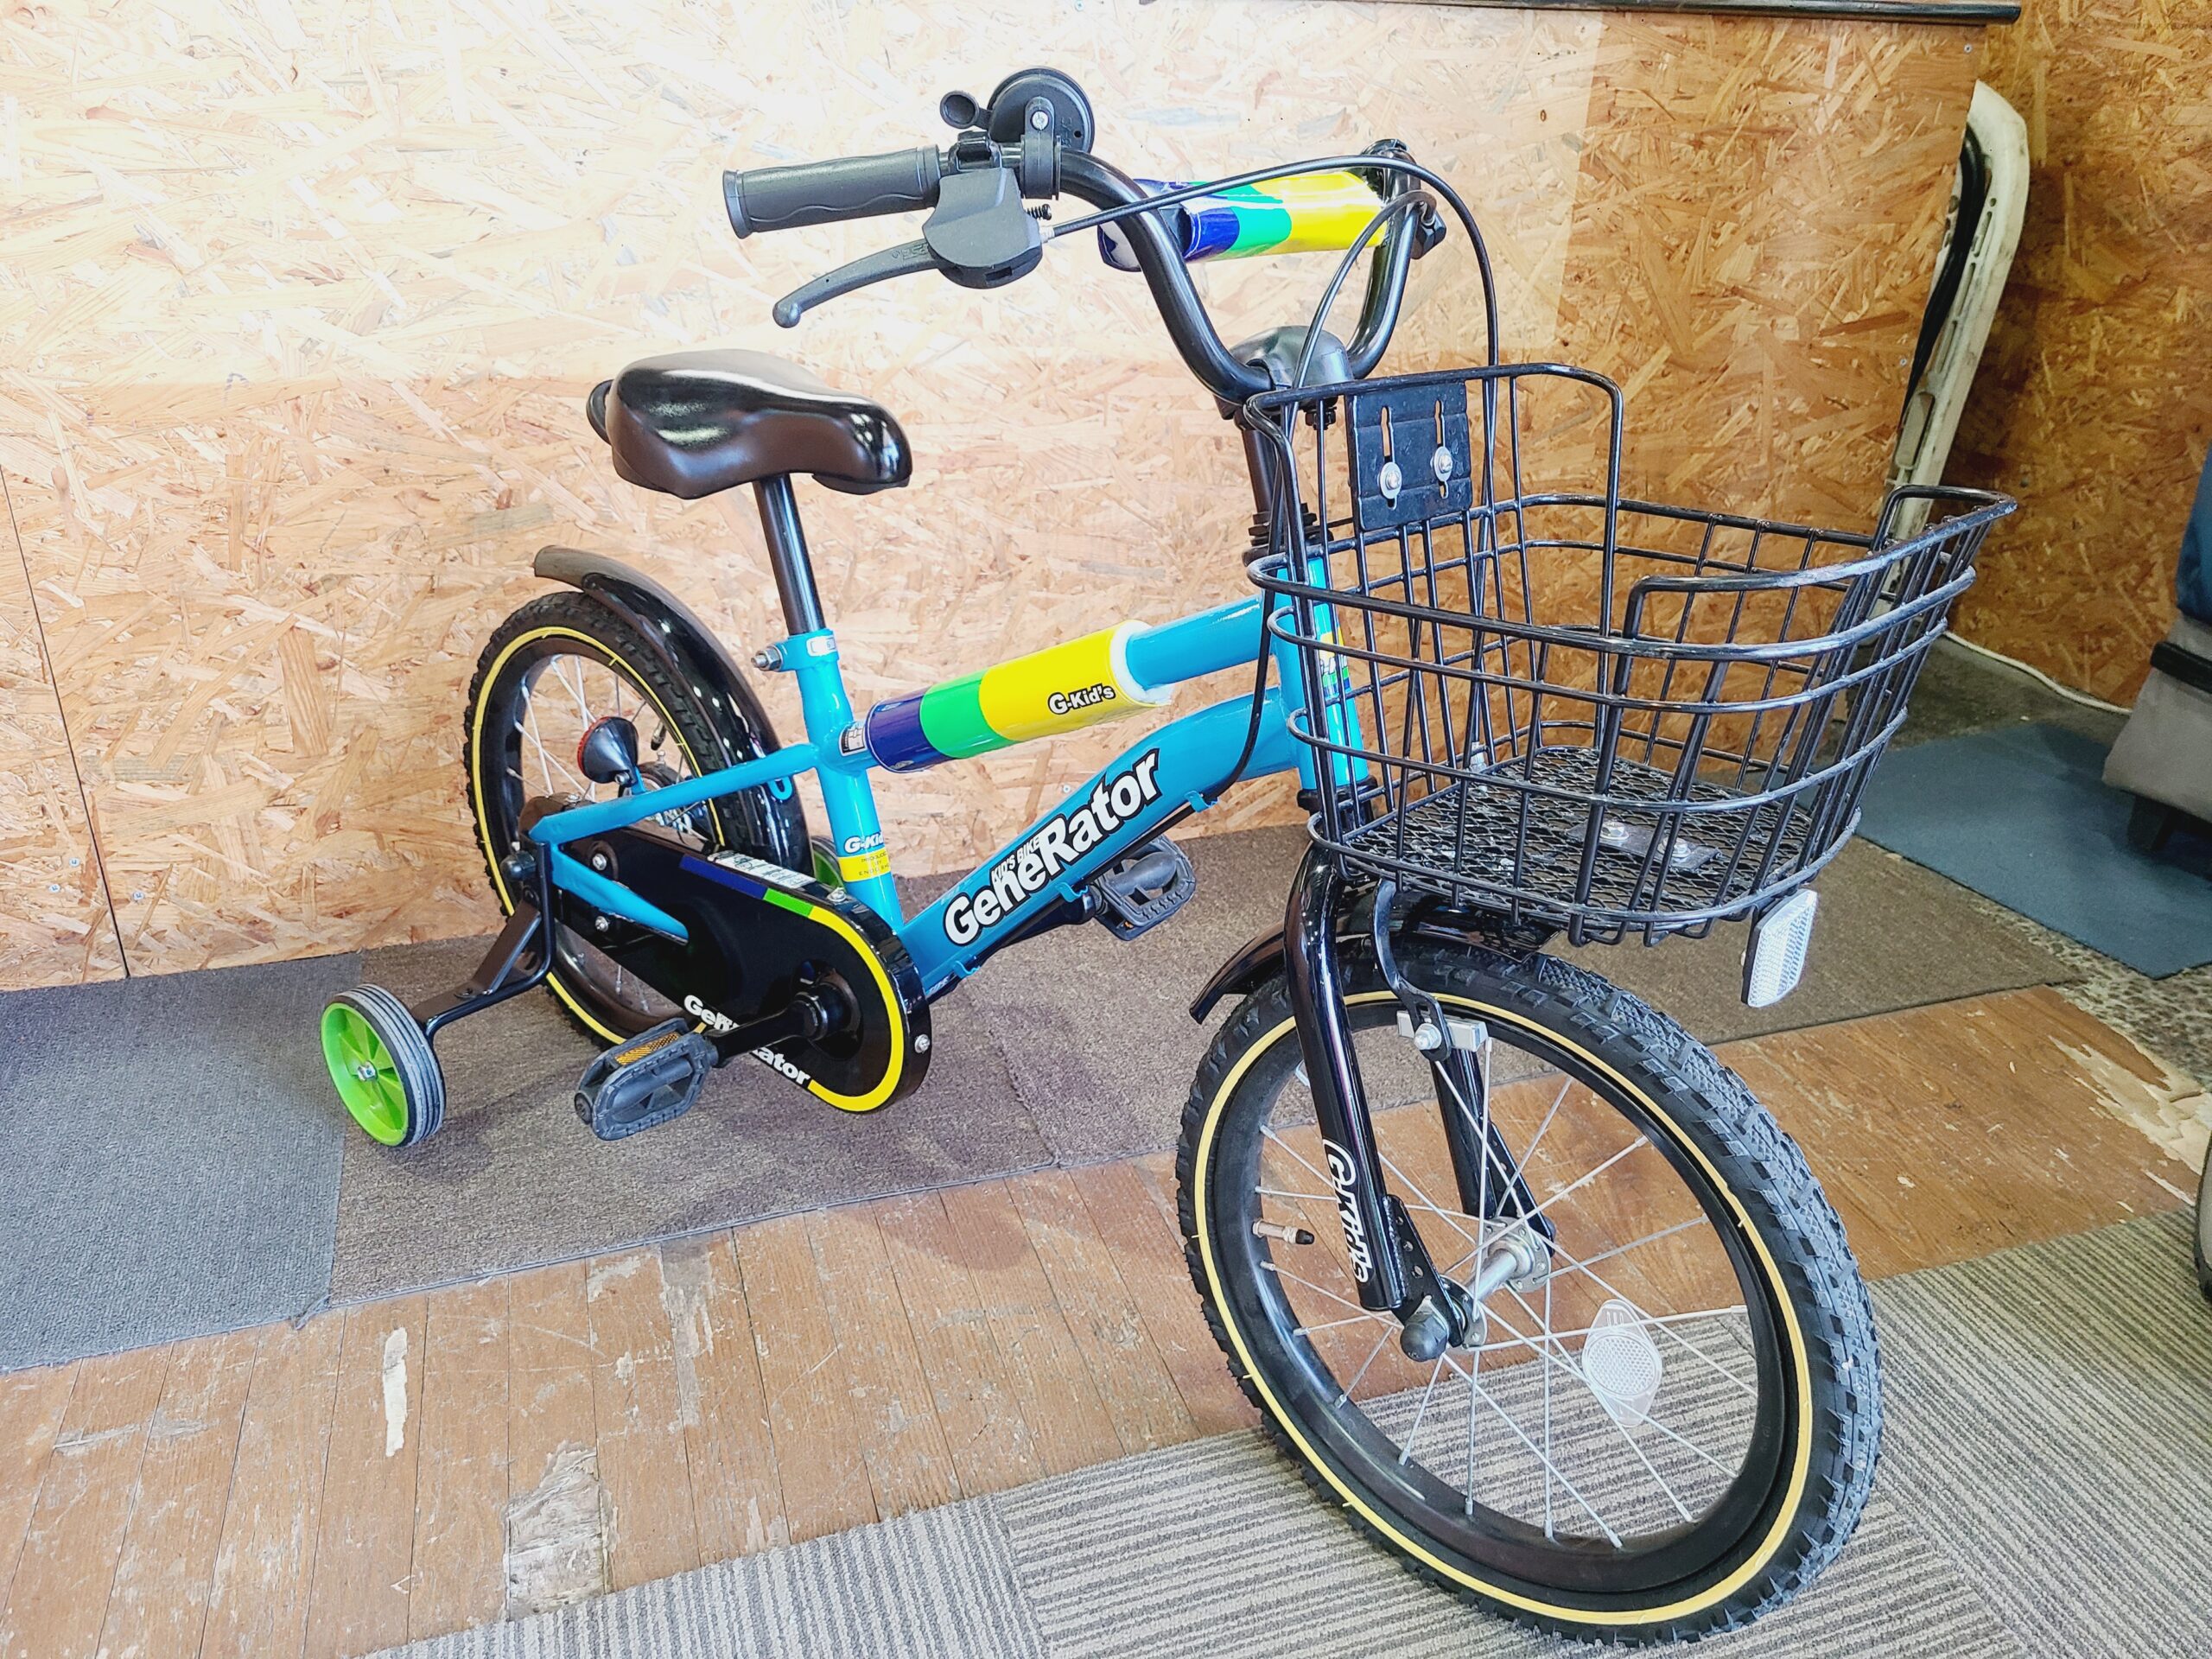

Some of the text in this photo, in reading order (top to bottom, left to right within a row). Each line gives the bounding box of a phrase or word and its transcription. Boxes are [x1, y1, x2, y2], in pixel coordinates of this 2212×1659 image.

[1048, 683, 1116, 715] G-Kid's
[944, 749, 1161, 946] GeneRator
[991, 836, 1040, 883] KID'S BIKE
[683, 995, 810, 1084] Genator
